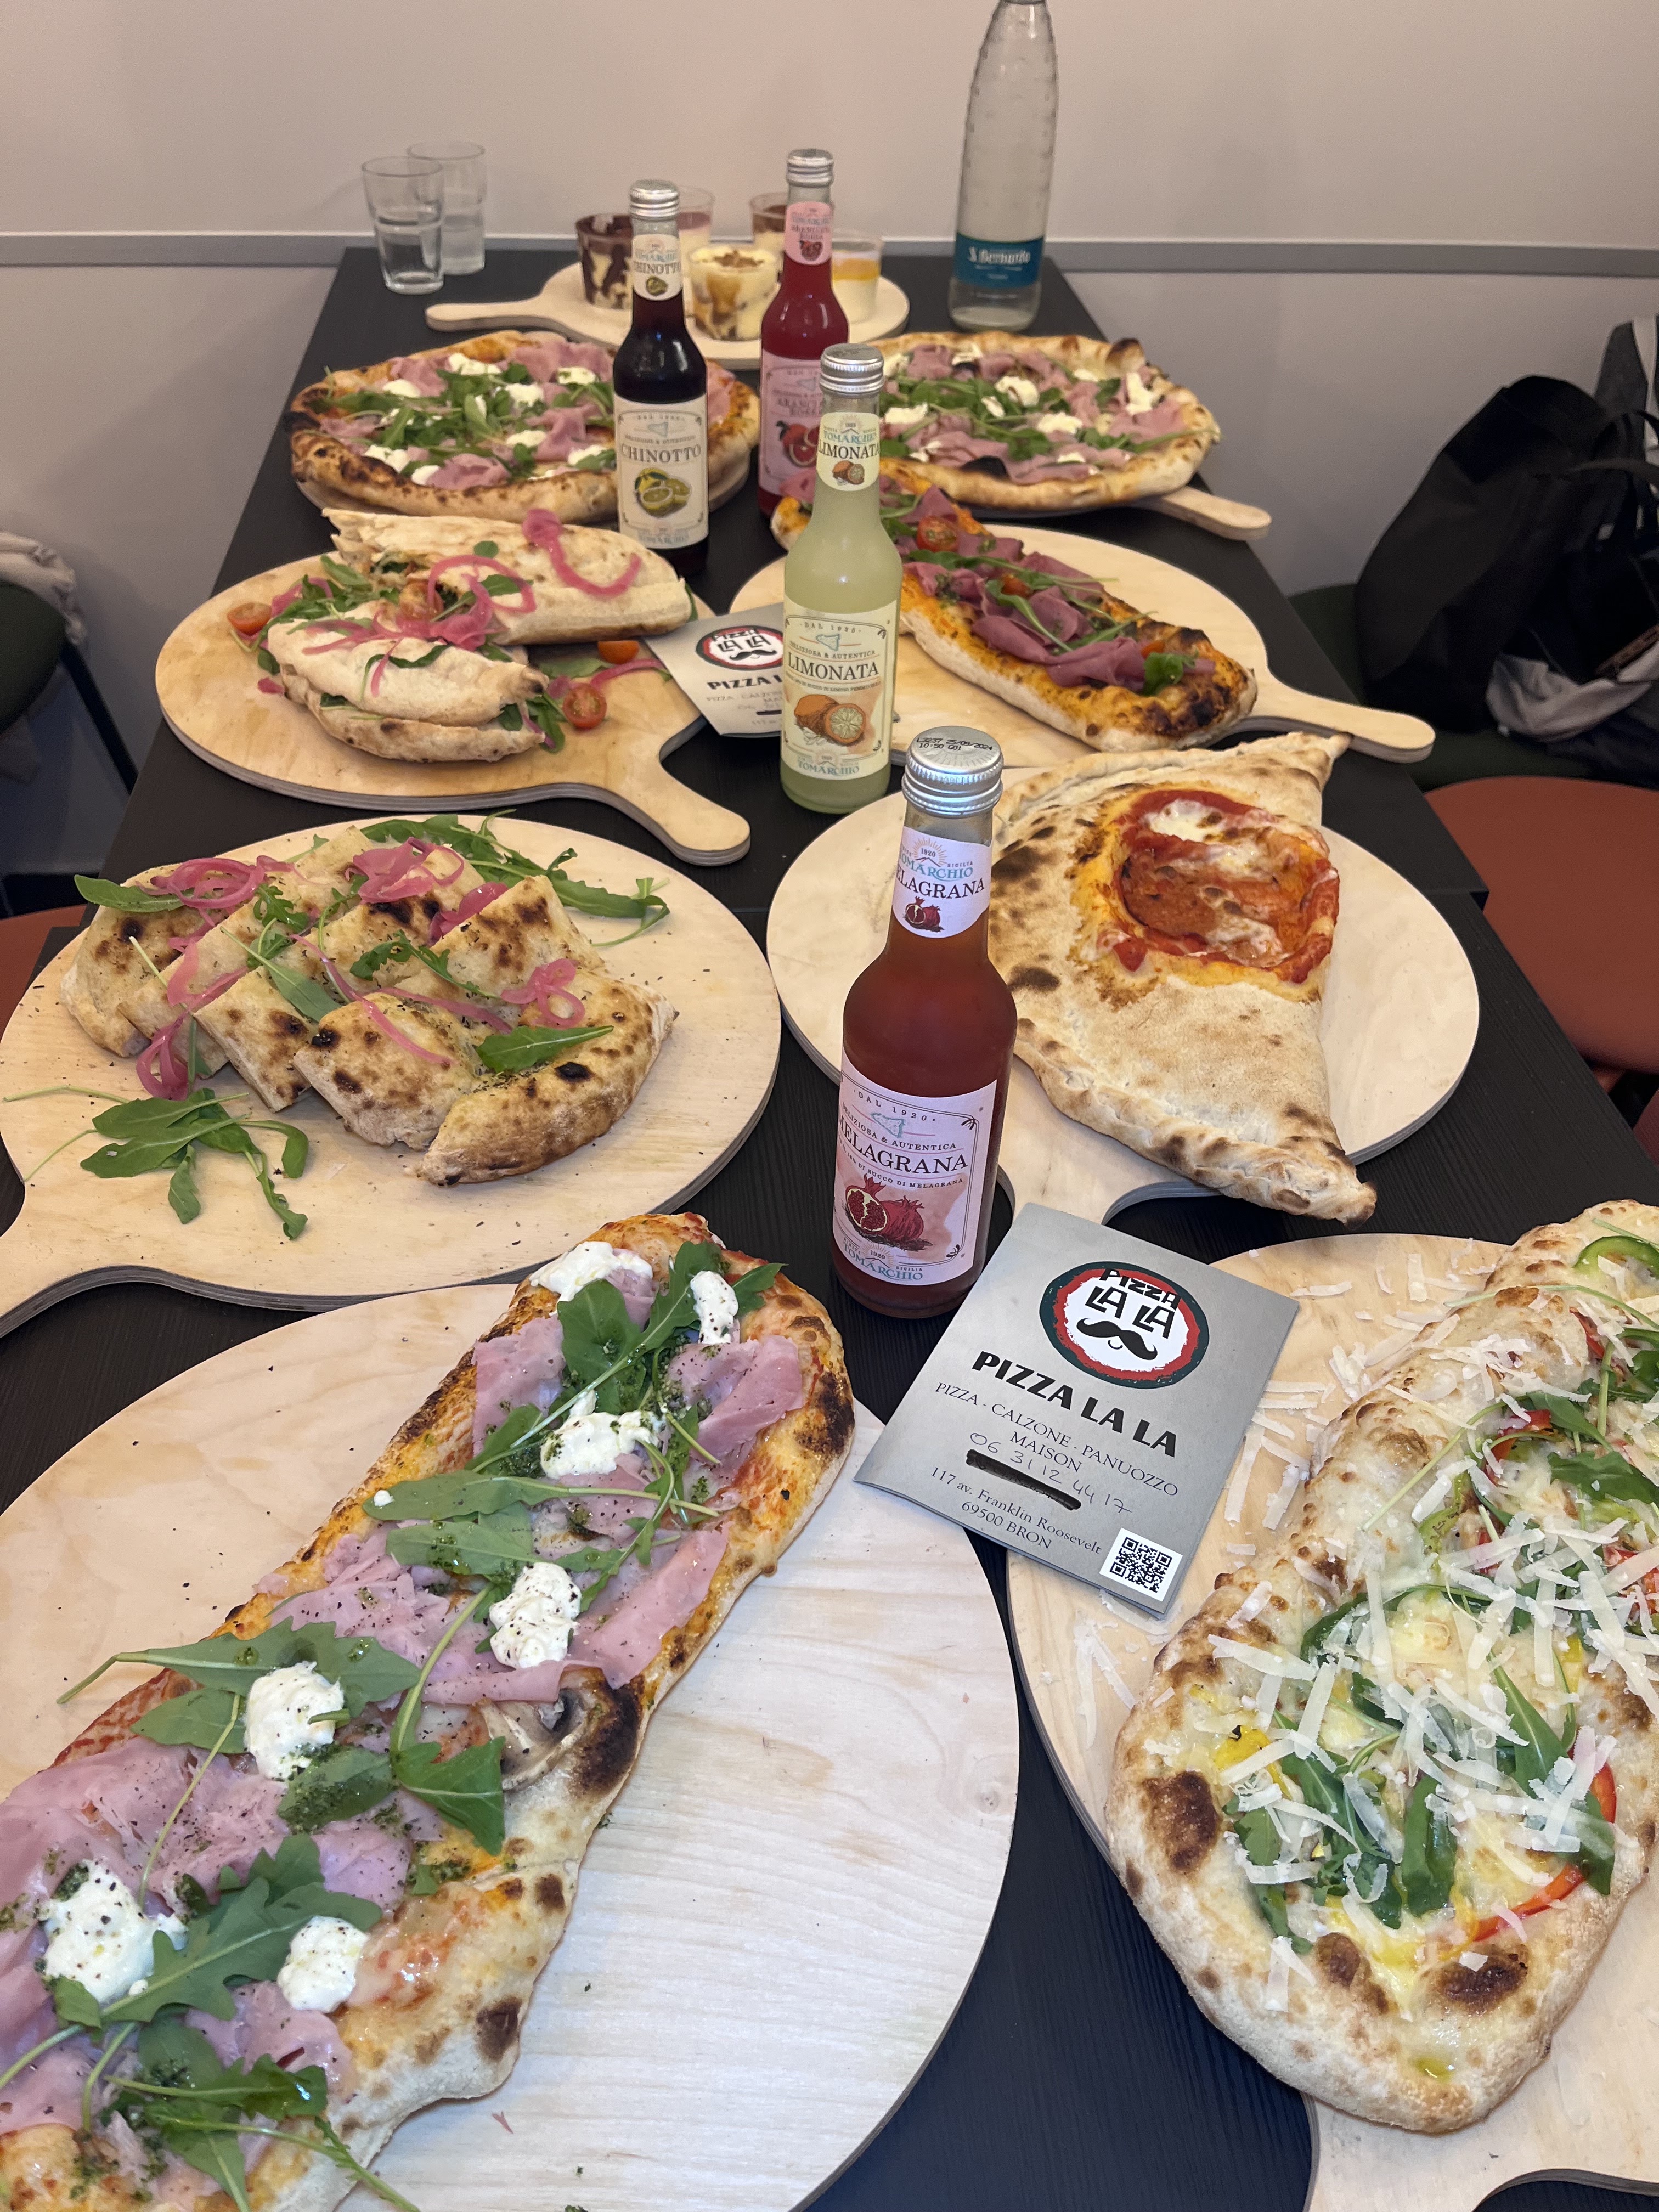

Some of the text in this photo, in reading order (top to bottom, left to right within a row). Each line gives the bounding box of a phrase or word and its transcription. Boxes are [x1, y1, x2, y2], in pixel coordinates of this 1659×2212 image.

[621, 442, 701, 464] CHINOTTO
[713, 629, 759, 641] PIZZA
[717, 635, 771, 652] LA LA
[707, 676, 771, 690] PIZZA
[788, 651, 879, 681] LIMONATA
[921, 848, 936, 857] 1920
[896, 864, 985, 899] ELAGRANA
[858, 1091, 927, 1121] DAL 1920
[838, 1107, 968, 1174] MELAGRANA
[842, 1101, 878, 1139] DELIZIOSA
[891, 1141, 956, 1151] AUTENTICA
[858, 1163, 865, 1171] DI
[867, 1169, 893, 1183] SUCCO
[909, 1178, 963, 1188] MELAGRANA
[844, 1244, 923, 1280] TOMARCHIO
[1099, 1268, 1180, 1311] PIZZA
[1085, 1286, 1175, 1339] LA LA
[972, 1351, 1177, 1458] PIZZA LA LA
[934, 1382, 978, 1406] PIZZA
[991, 1403, 1071, 1448] CALZONE
[1082, 1444, 1178, 1496] PANUOZZO
[970, 1432, 1002, 1453] 06
[1009, 1431, 1082, 1472] MAISON
[930, 1466, 956, 1485] 117
[957, 1481, 973, 1495] av.
[977, 1488, 1032, 1524] Franklin
[1036, 1516, 1102, 1555] Roosevelt
[962, 1501, 1053, 1550] 69500 BRON
